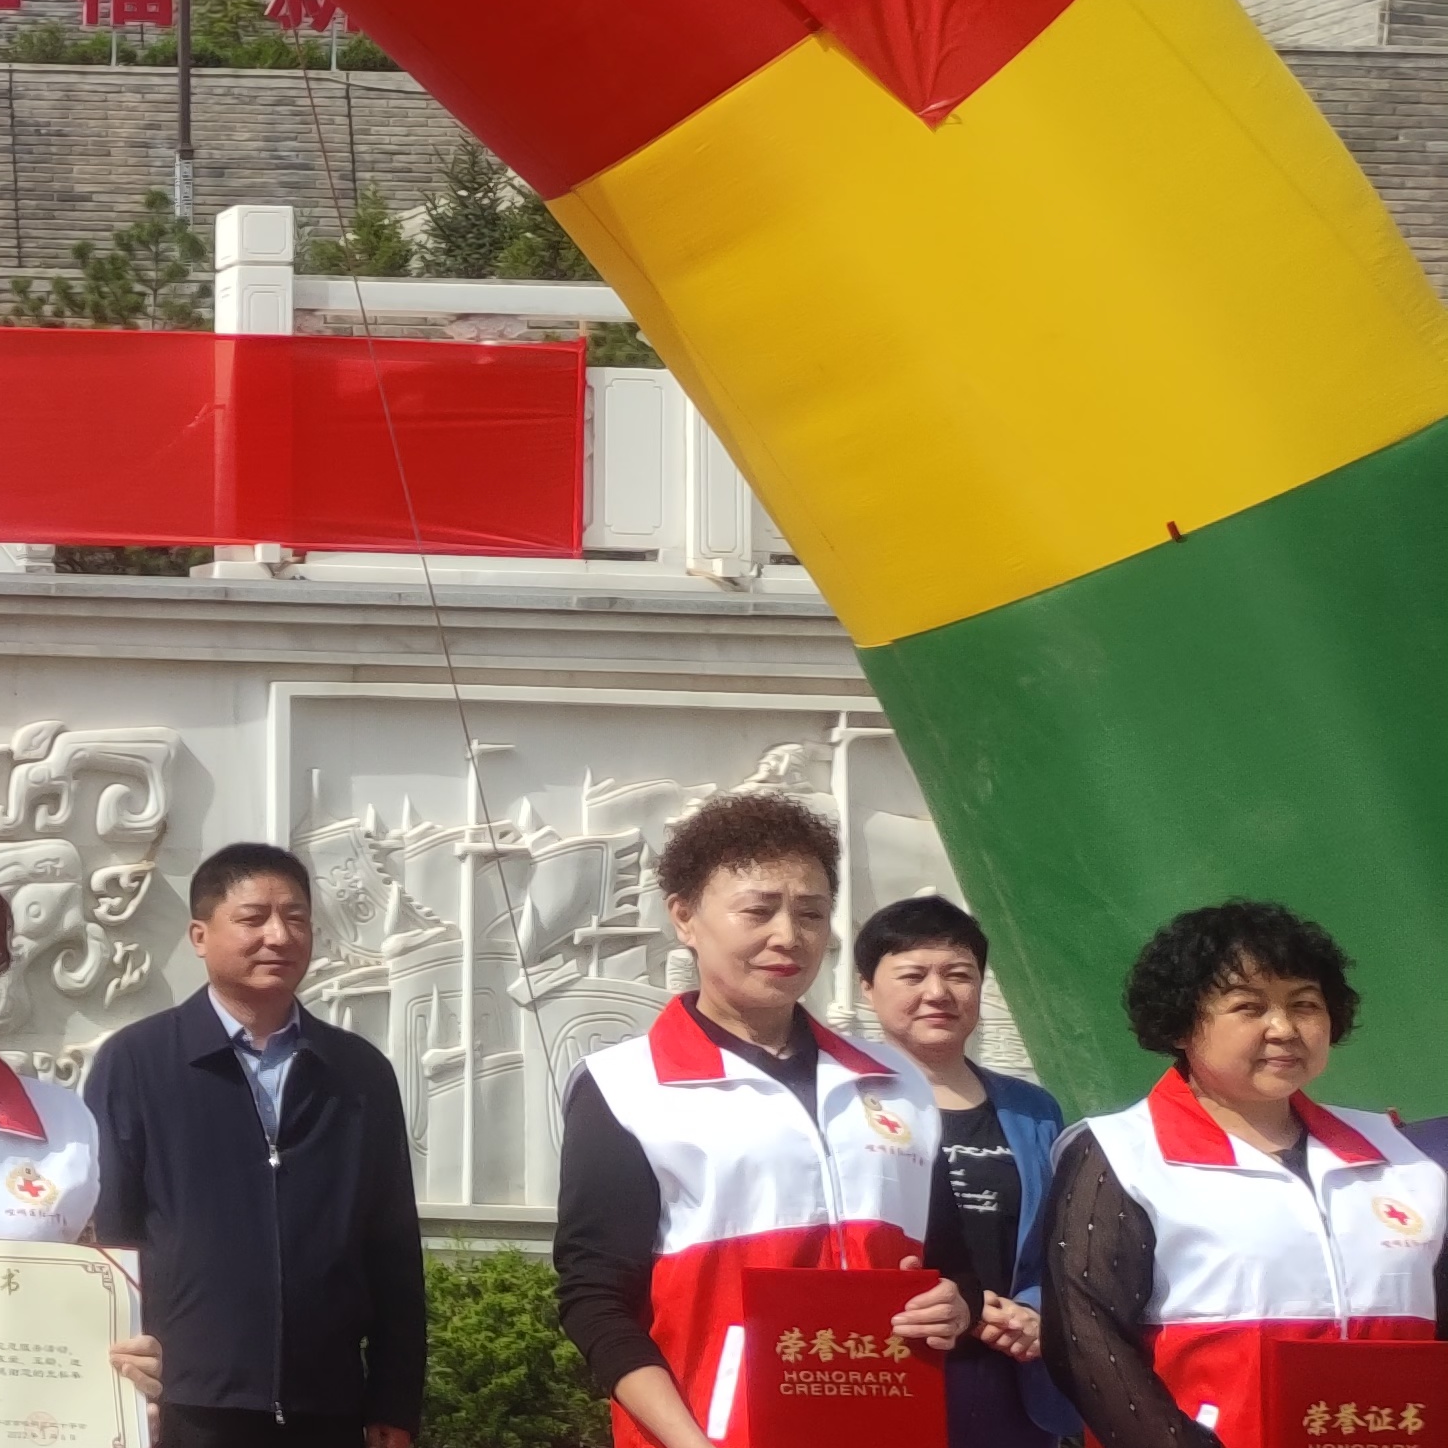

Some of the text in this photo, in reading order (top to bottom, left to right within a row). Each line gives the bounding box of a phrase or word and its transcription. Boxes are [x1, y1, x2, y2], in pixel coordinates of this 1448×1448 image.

[776, 1327, 911, 1363] 荣誉证书
[783, 1370, 906, 1383] HONORARY
[779, 1383, 914, 1397] CREDENTIAL
[1302, 1400, 1426, 1436] 荣誉证书
